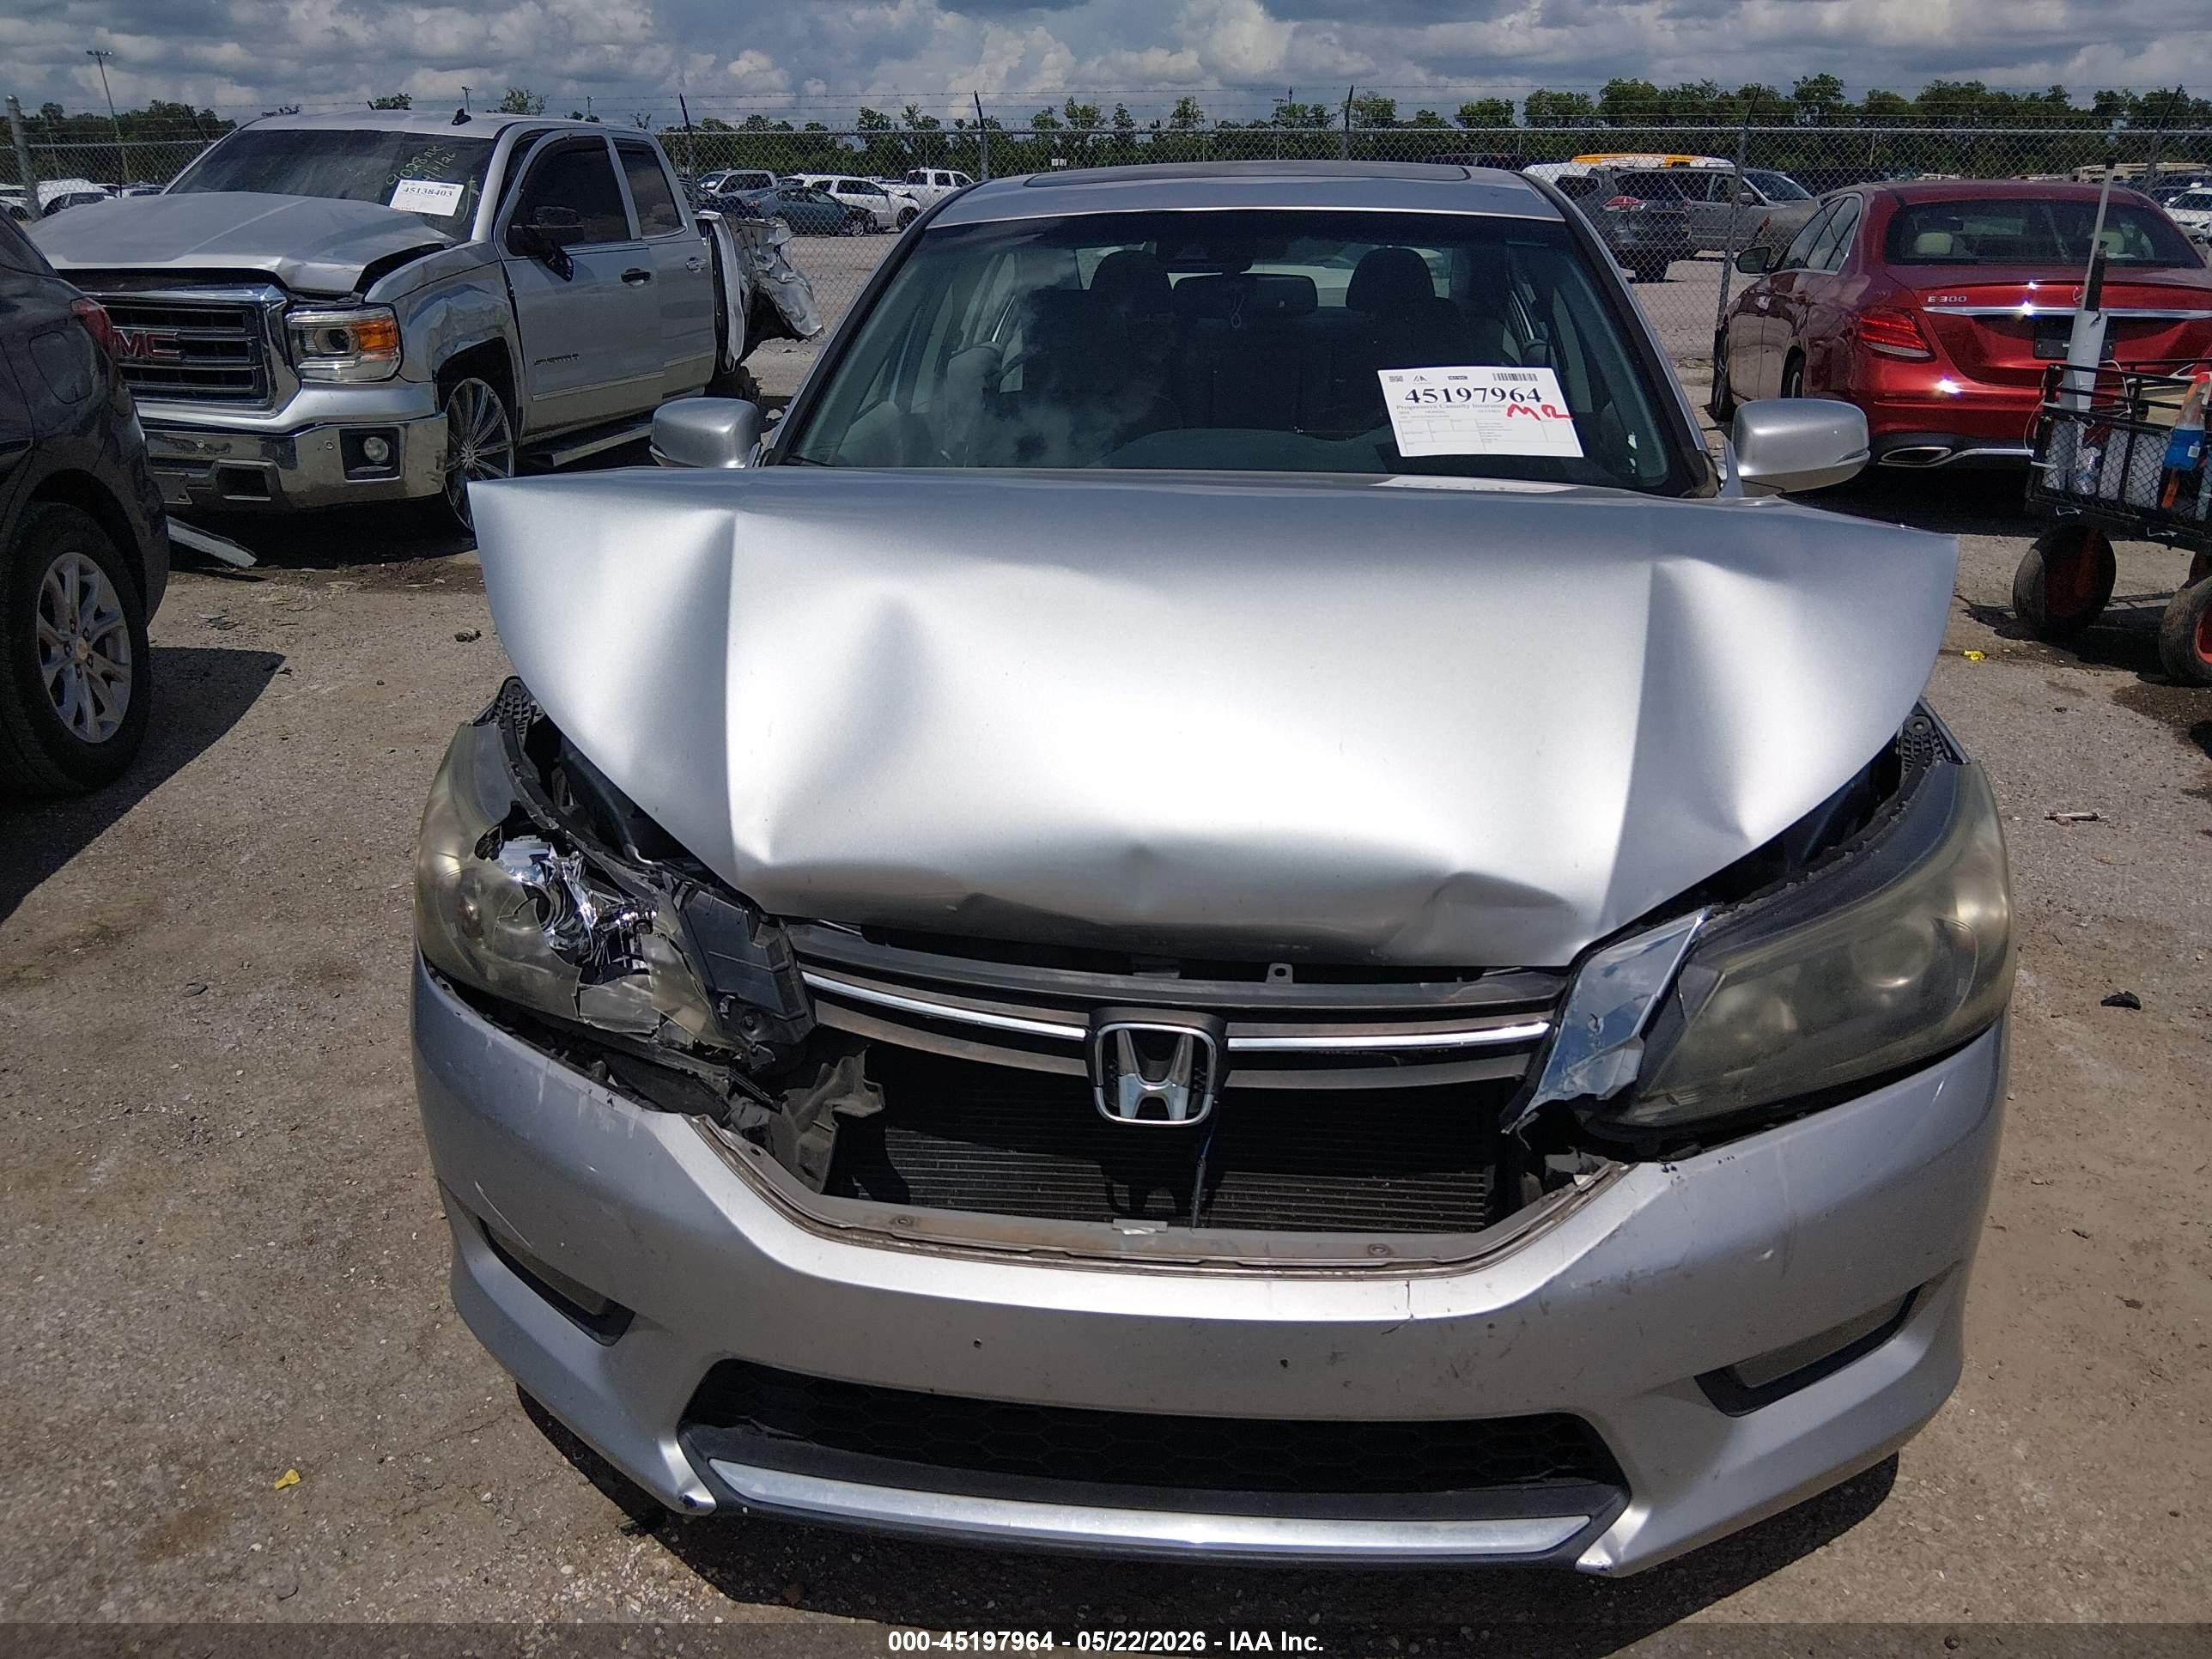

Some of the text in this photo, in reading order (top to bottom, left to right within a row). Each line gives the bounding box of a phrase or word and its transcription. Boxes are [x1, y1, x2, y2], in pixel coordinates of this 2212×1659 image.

[403, 186, 453, 198] 45138403
[112, 329, 182, 359] MC
[1405, 386, 1542, 404] 45197964
